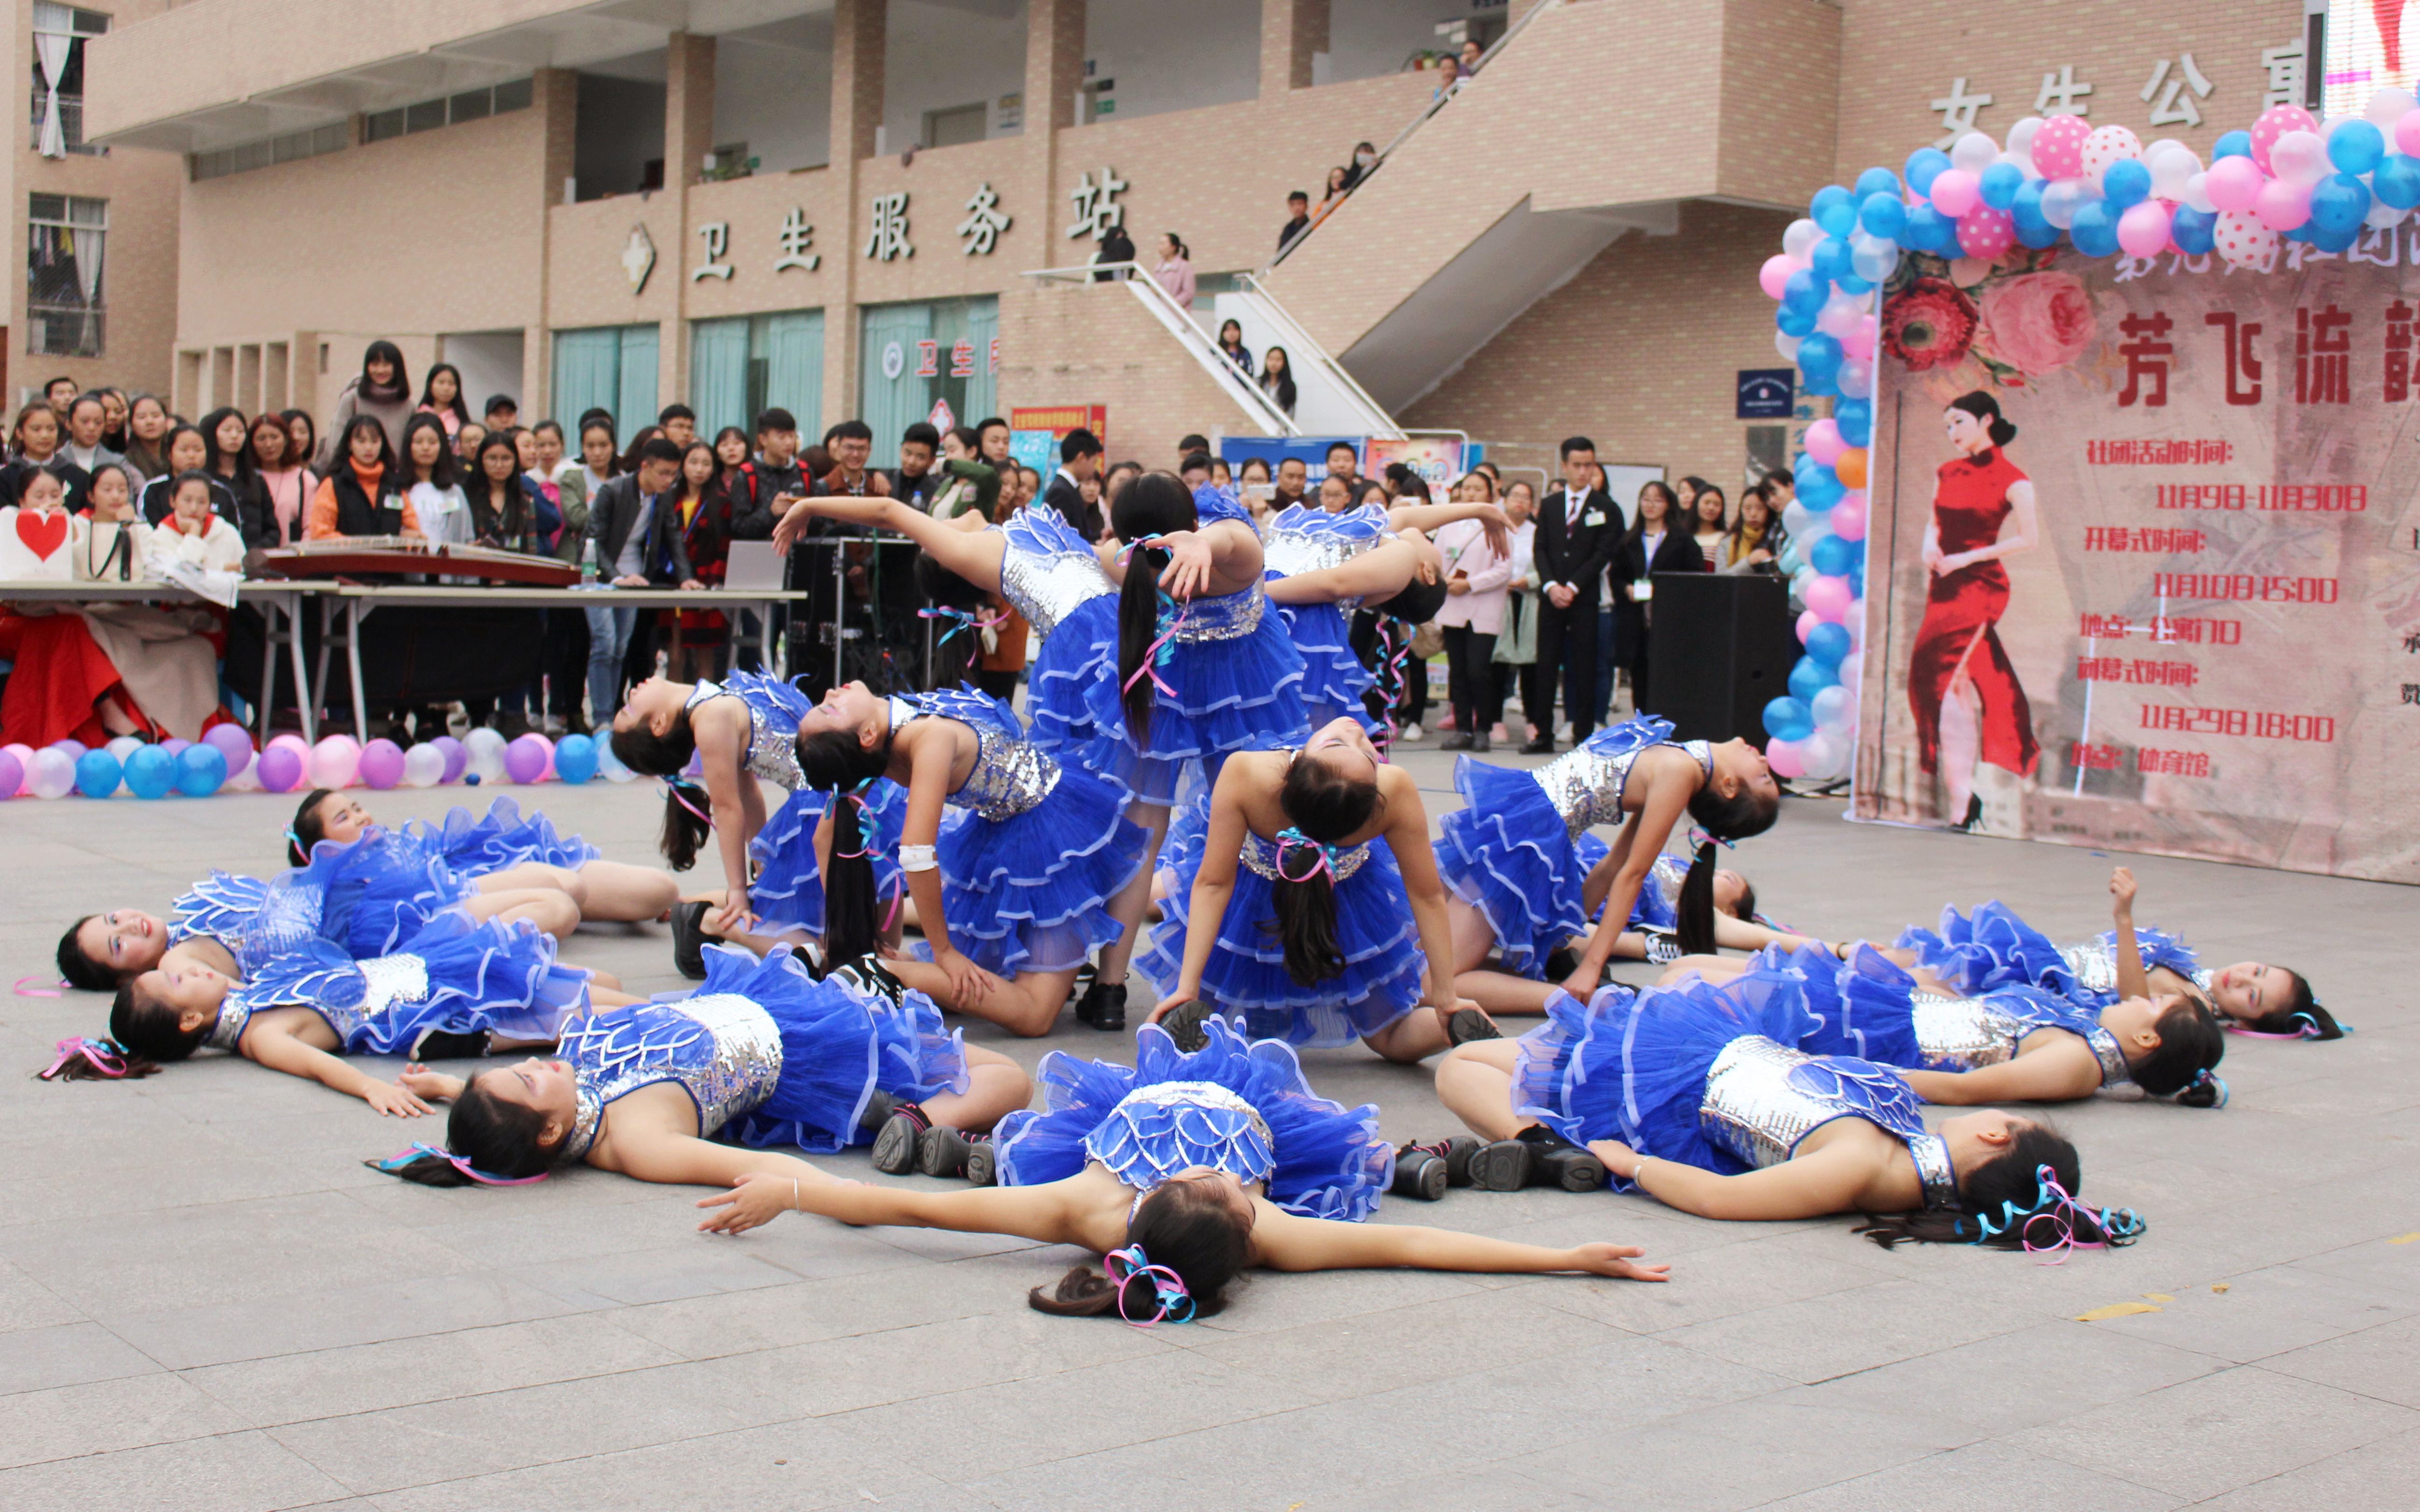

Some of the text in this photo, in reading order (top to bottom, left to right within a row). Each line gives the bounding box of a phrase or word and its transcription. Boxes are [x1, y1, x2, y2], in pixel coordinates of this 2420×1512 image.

[691, 166, 1130, 282] 卫生服务站
[2087, 440, 2233, 465] 社团活动时间:
[2084, 526, 2207, 554] 开幕式时间:
[2262, 576, 2338, 604] 15:00
[2254, 712, 2335, 743] 18:00
